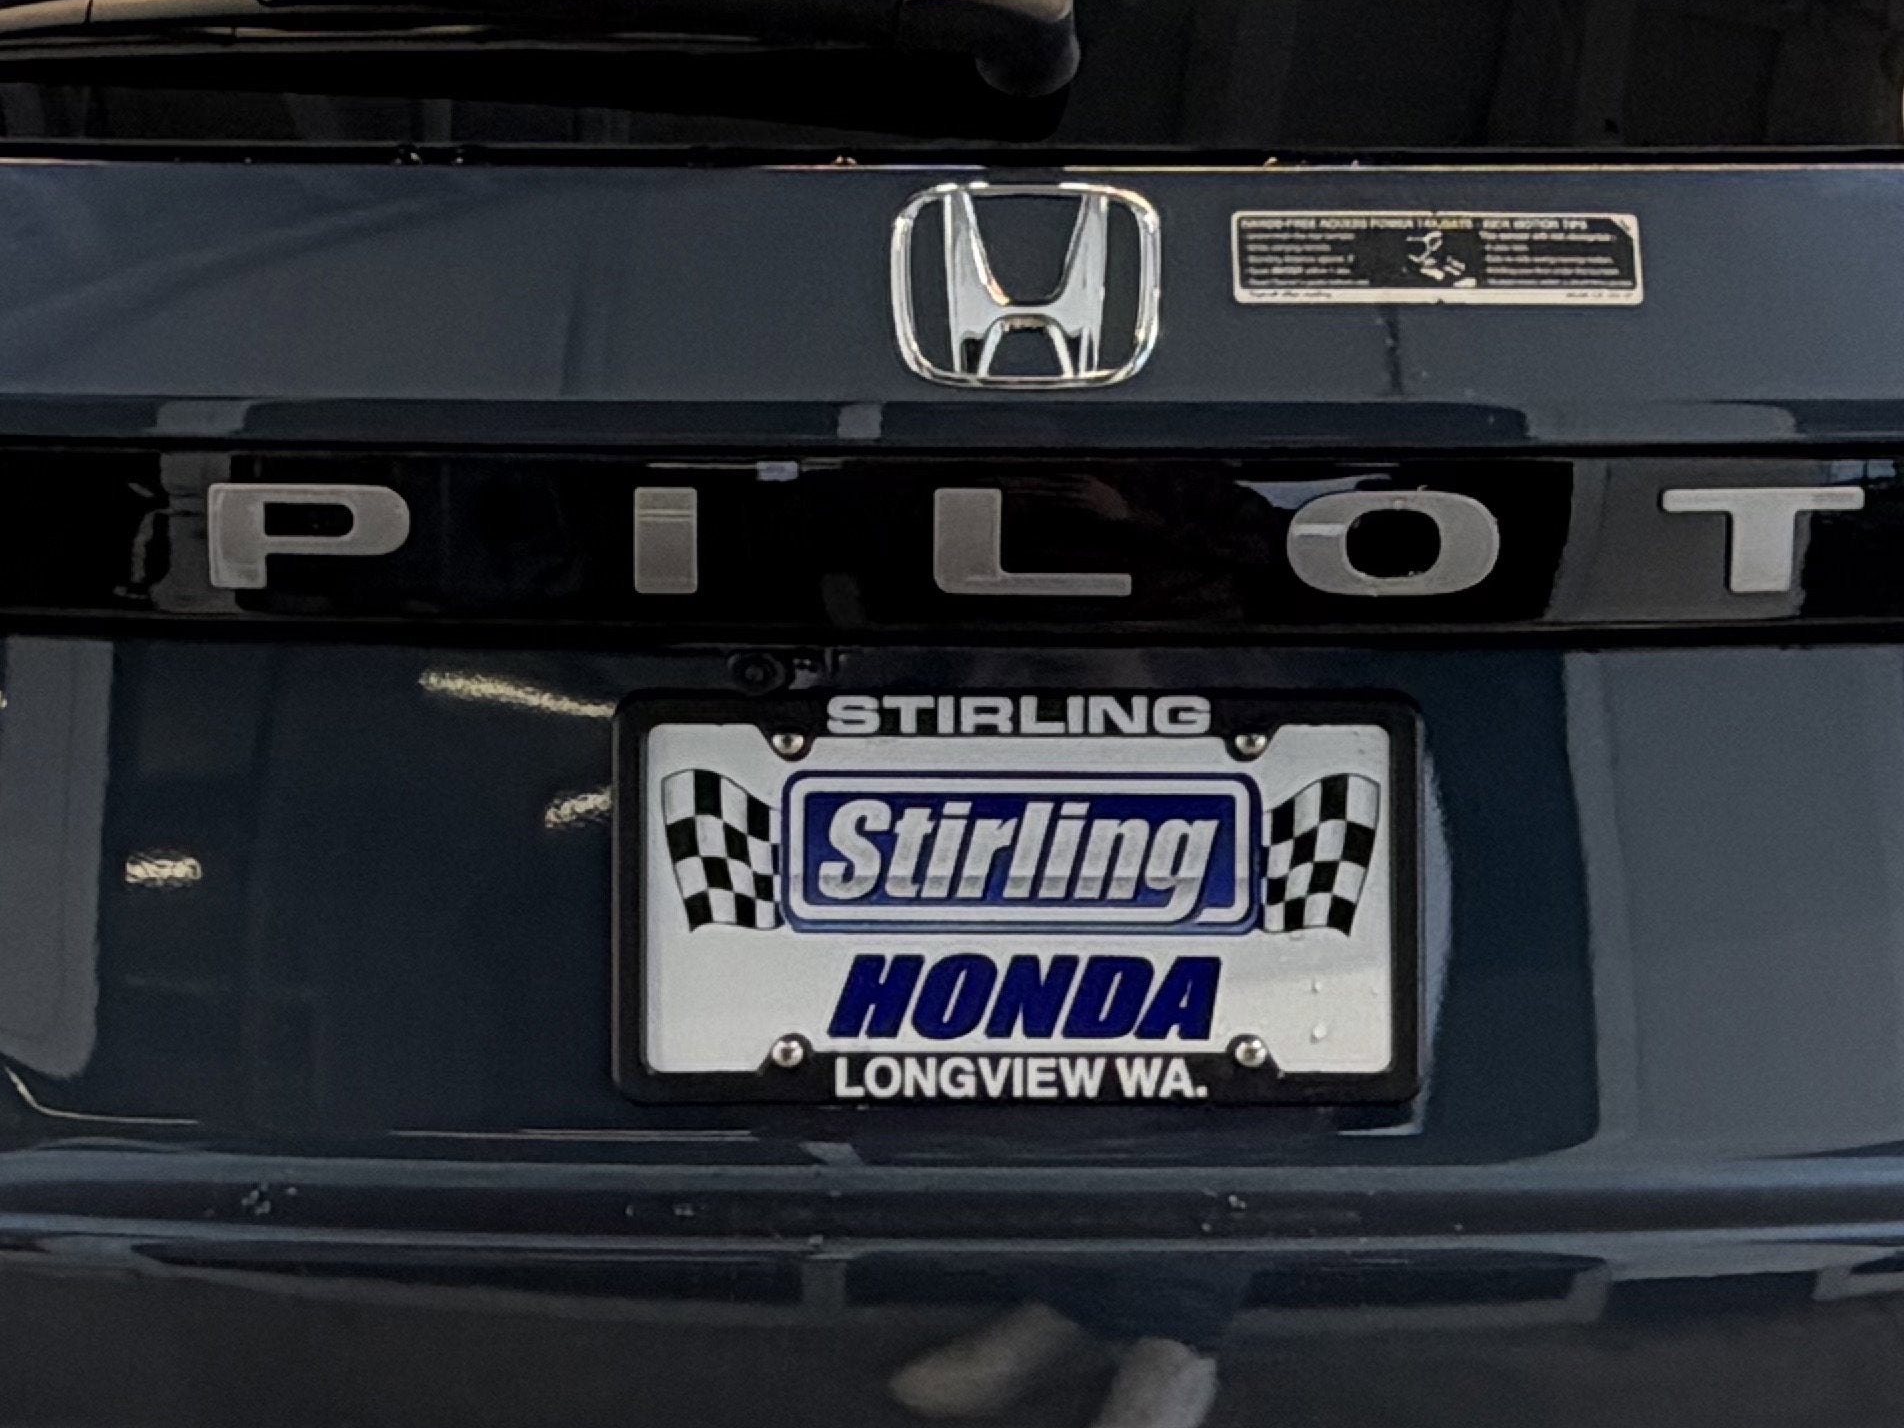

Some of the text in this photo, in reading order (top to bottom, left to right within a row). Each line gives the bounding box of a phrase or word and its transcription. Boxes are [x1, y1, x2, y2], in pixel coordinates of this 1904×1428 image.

[207, 480, 1866, 598] PILOT
[825, 694, 1212, 735] STIRLING
[817, 796, 1220, 920] Stirling
[826, 953, 1223, 1040] HONDA
[834, 1056, 1208, 1099] LONGVIEW WA.
